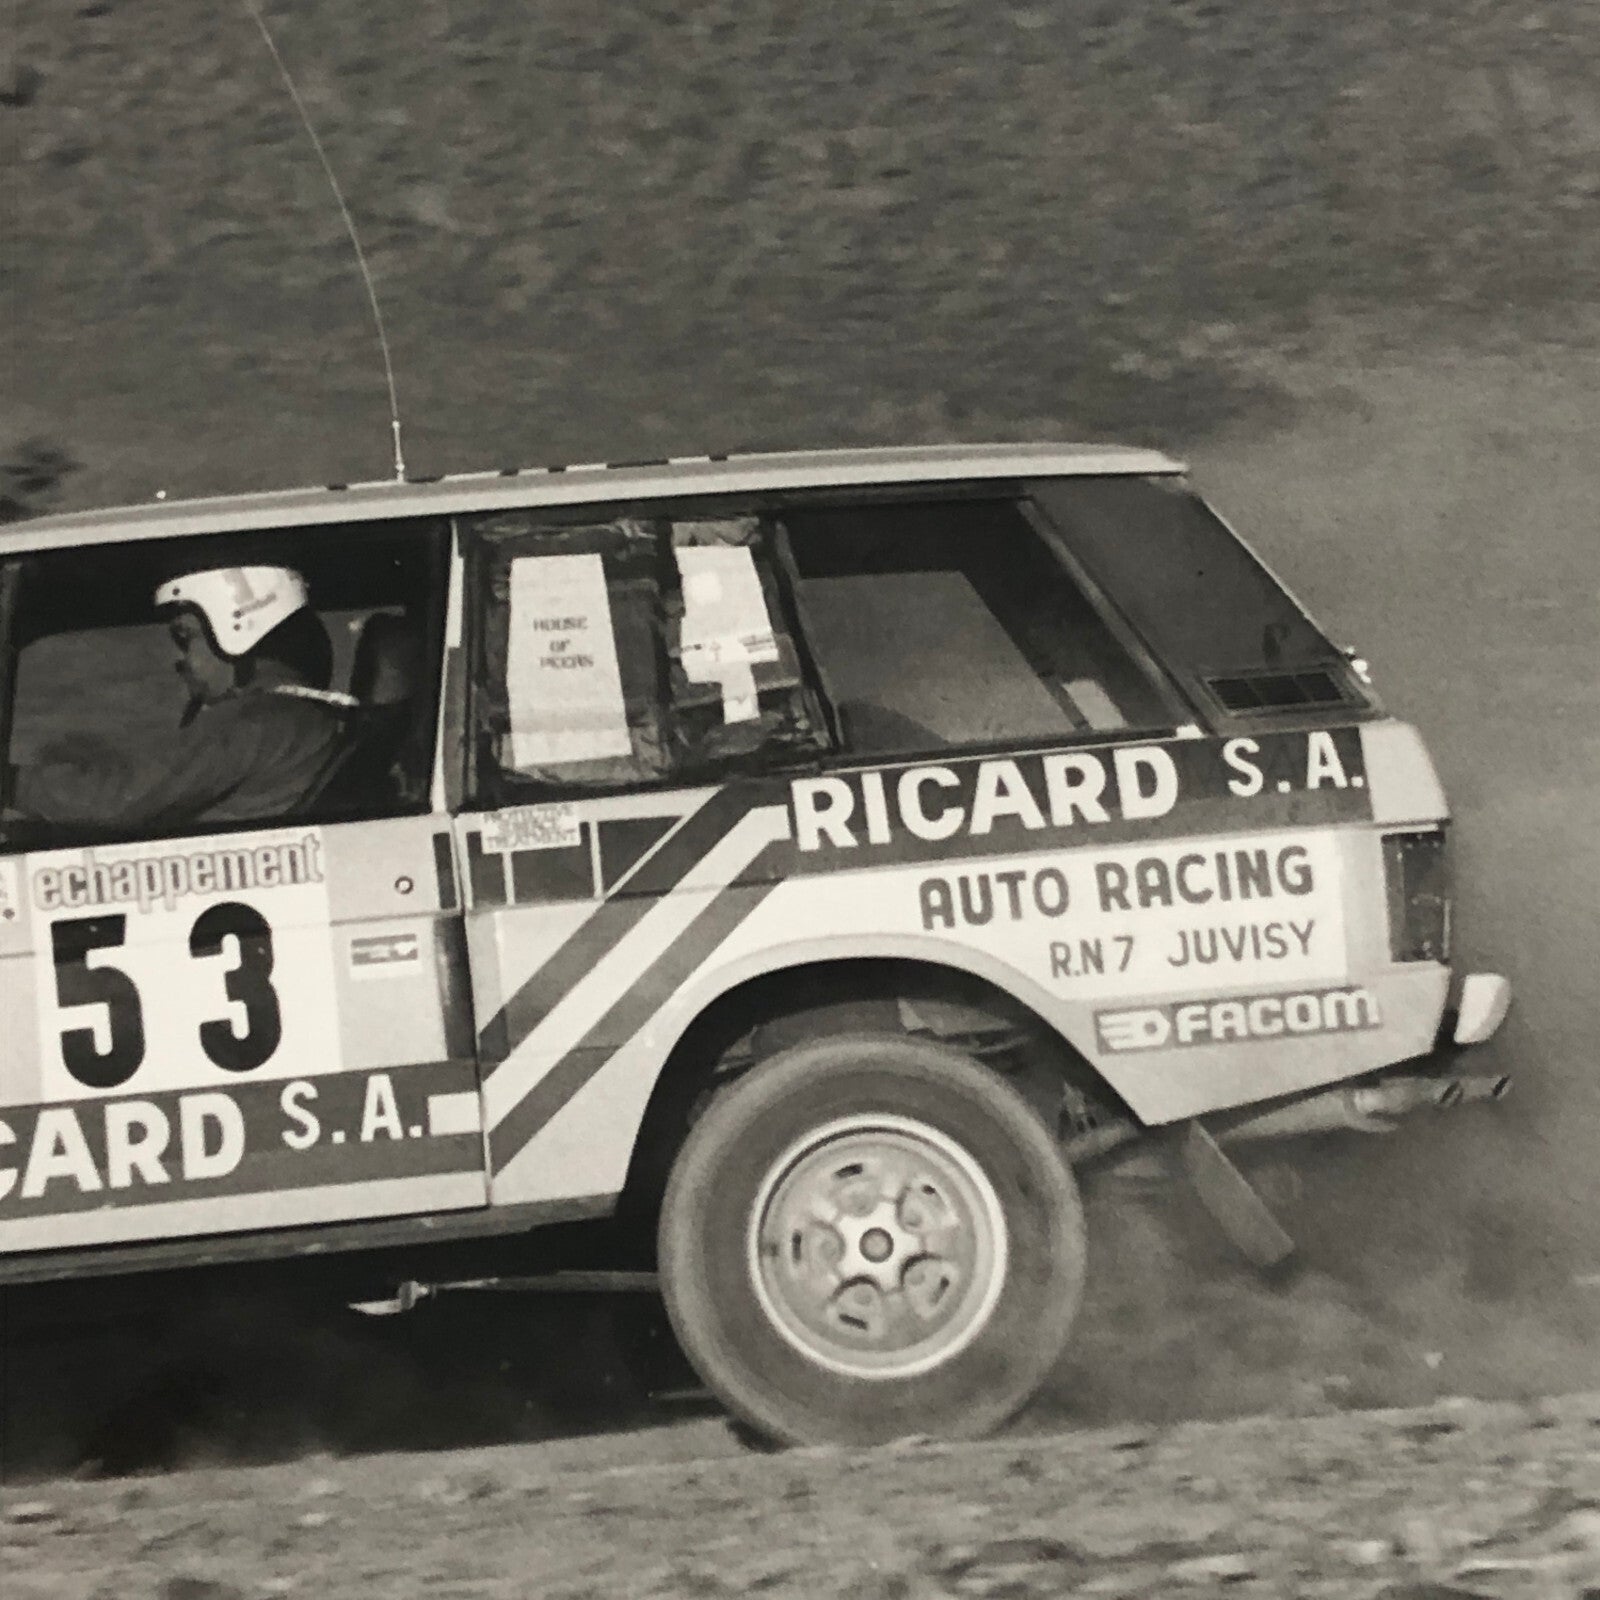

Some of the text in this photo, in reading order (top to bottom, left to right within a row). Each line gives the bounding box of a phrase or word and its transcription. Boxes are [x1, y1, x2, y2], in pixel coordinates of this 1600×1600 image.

[790, 731, 1365, 853] RICARD S.A.
[34, 833, 325, 914] echappement
[919, 844, 1315, 932] AUTO RACING
[1167, 919, 1315, 967] JUVISY
[0, 1073, 423, 1201] ARD S.A.
